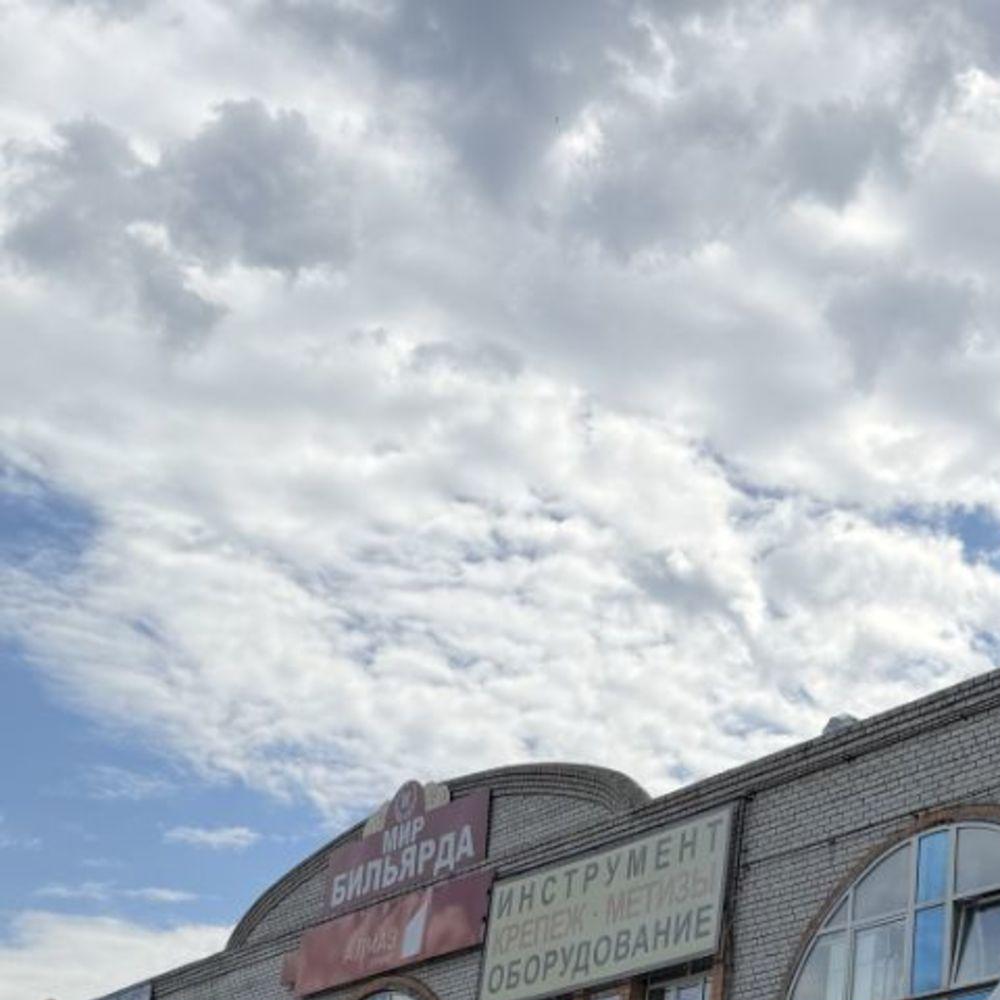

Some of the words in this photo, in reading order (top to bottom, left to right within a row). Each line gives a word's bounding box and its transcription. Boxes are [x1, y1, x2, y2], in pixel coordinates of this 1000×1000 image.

[331, 824, 475, 907] БИЛЬЯРДА
[382, 815, 425, 855] МИР
[496, 818, 724, 921] ИНСТРУМЕНТ
[605, 866, 714, 926] МЕТИЗЫ
[487, 903, 714, 995] ОБОРУДОВАНИЕ
